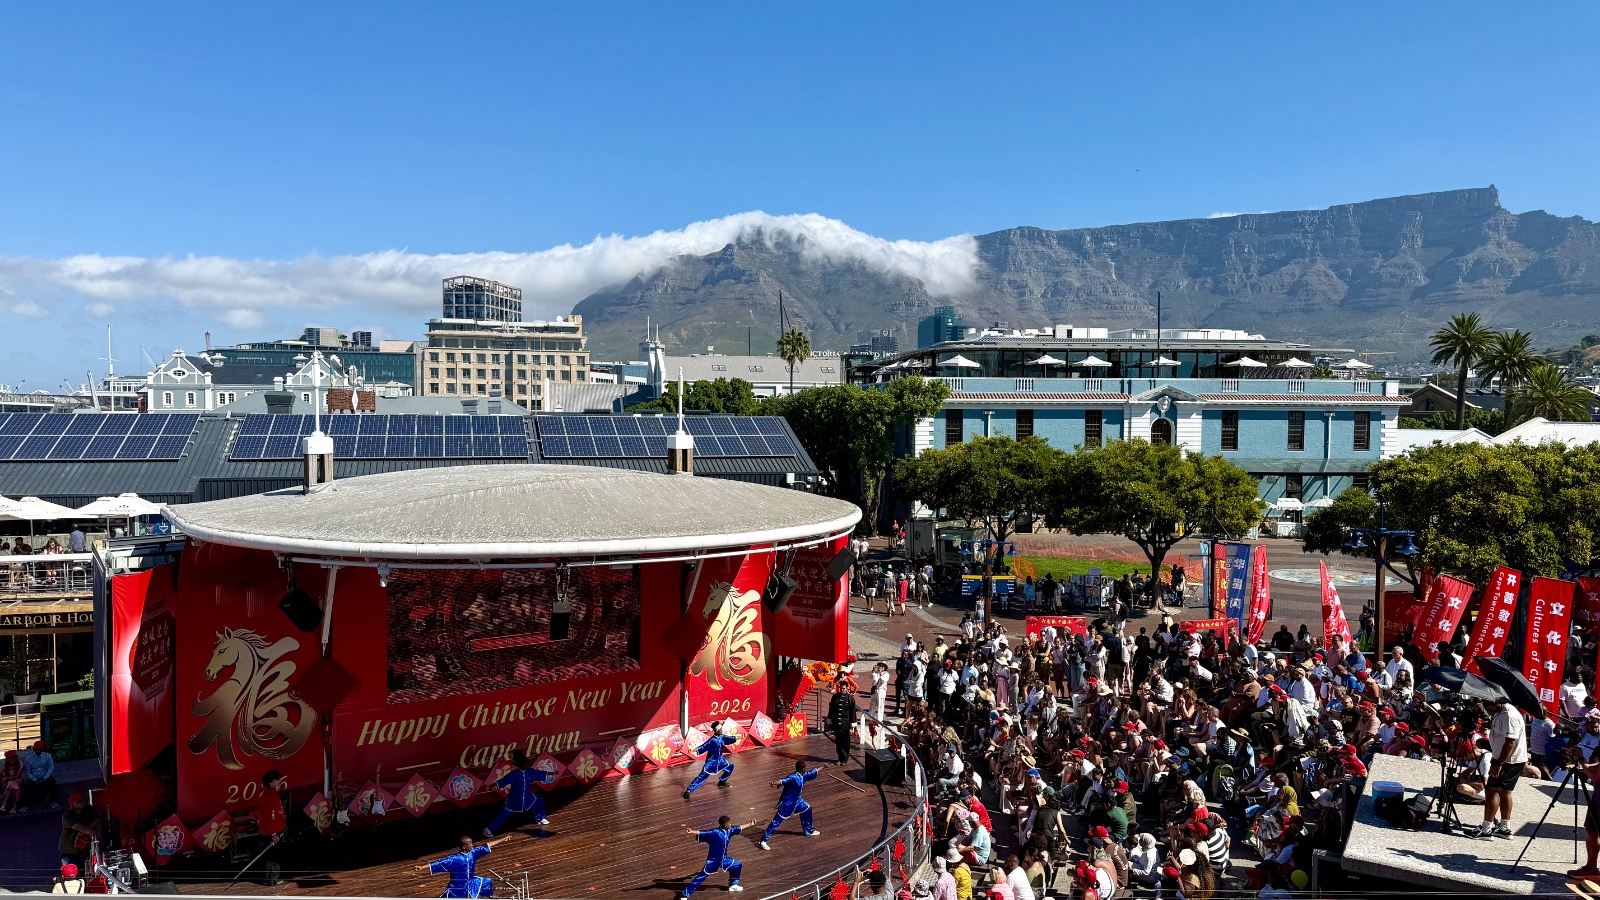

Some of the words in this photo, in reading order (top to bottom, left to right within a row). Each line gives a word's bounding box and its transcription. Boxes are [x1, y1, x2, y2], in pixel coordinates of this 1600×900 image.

[808, 349, 840, 358] ICTORIA
[1495, 571, 1505, 591] Cape
[1425, 591, 1447, 628] Cultures
[1489, 592, 1501, 612] Town
[0, 614, 62, 627] ARBOUR
[1532, 598, 1546, 644] Cultures
[1419, 631, 1427, 642] of
[1531, 650, 1540, 663] of
[1540, 601, 1566, 703] 文化中国
[357, 713, 450, 747] Happy
[458, 696, 557, 730] Chinese
[562, 687, 612, 714] New
[619, 678, 667, 703] Year
[709, 697, 751, 717] 2026
[459, 741, 517, 769] Cape
[525, 730, 581, 758] Town
[650, 736, 672, 765] 福
[577, 753, 599, 783] 福
[403, 781, 431, 813] 福
